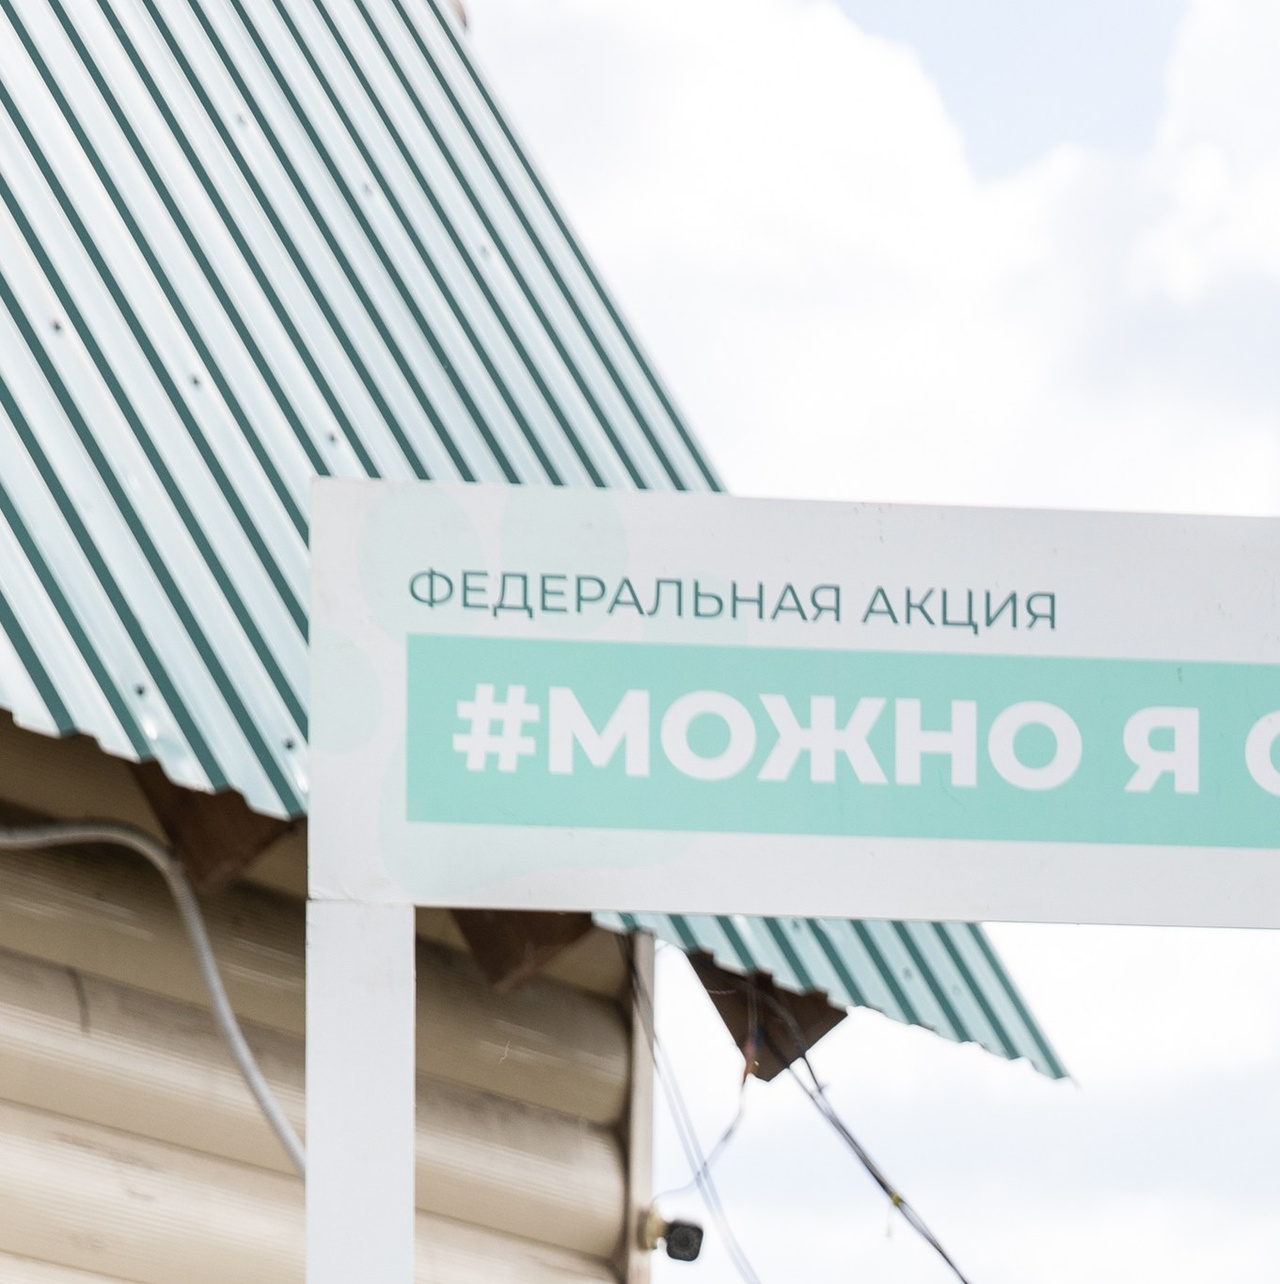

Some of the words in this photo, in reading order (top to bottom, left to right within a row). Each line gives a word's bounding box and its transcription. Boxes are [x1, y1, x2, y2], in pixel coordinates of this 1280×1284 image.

[408, 567, 841, 624] ФЕДЕРАЛЬНАЯ
[861, 584, 1058, 636] АКЦИЯ
[452, 682, 1084, 792] #МОЖНО
[1122, 706, 1200, 794] Я
